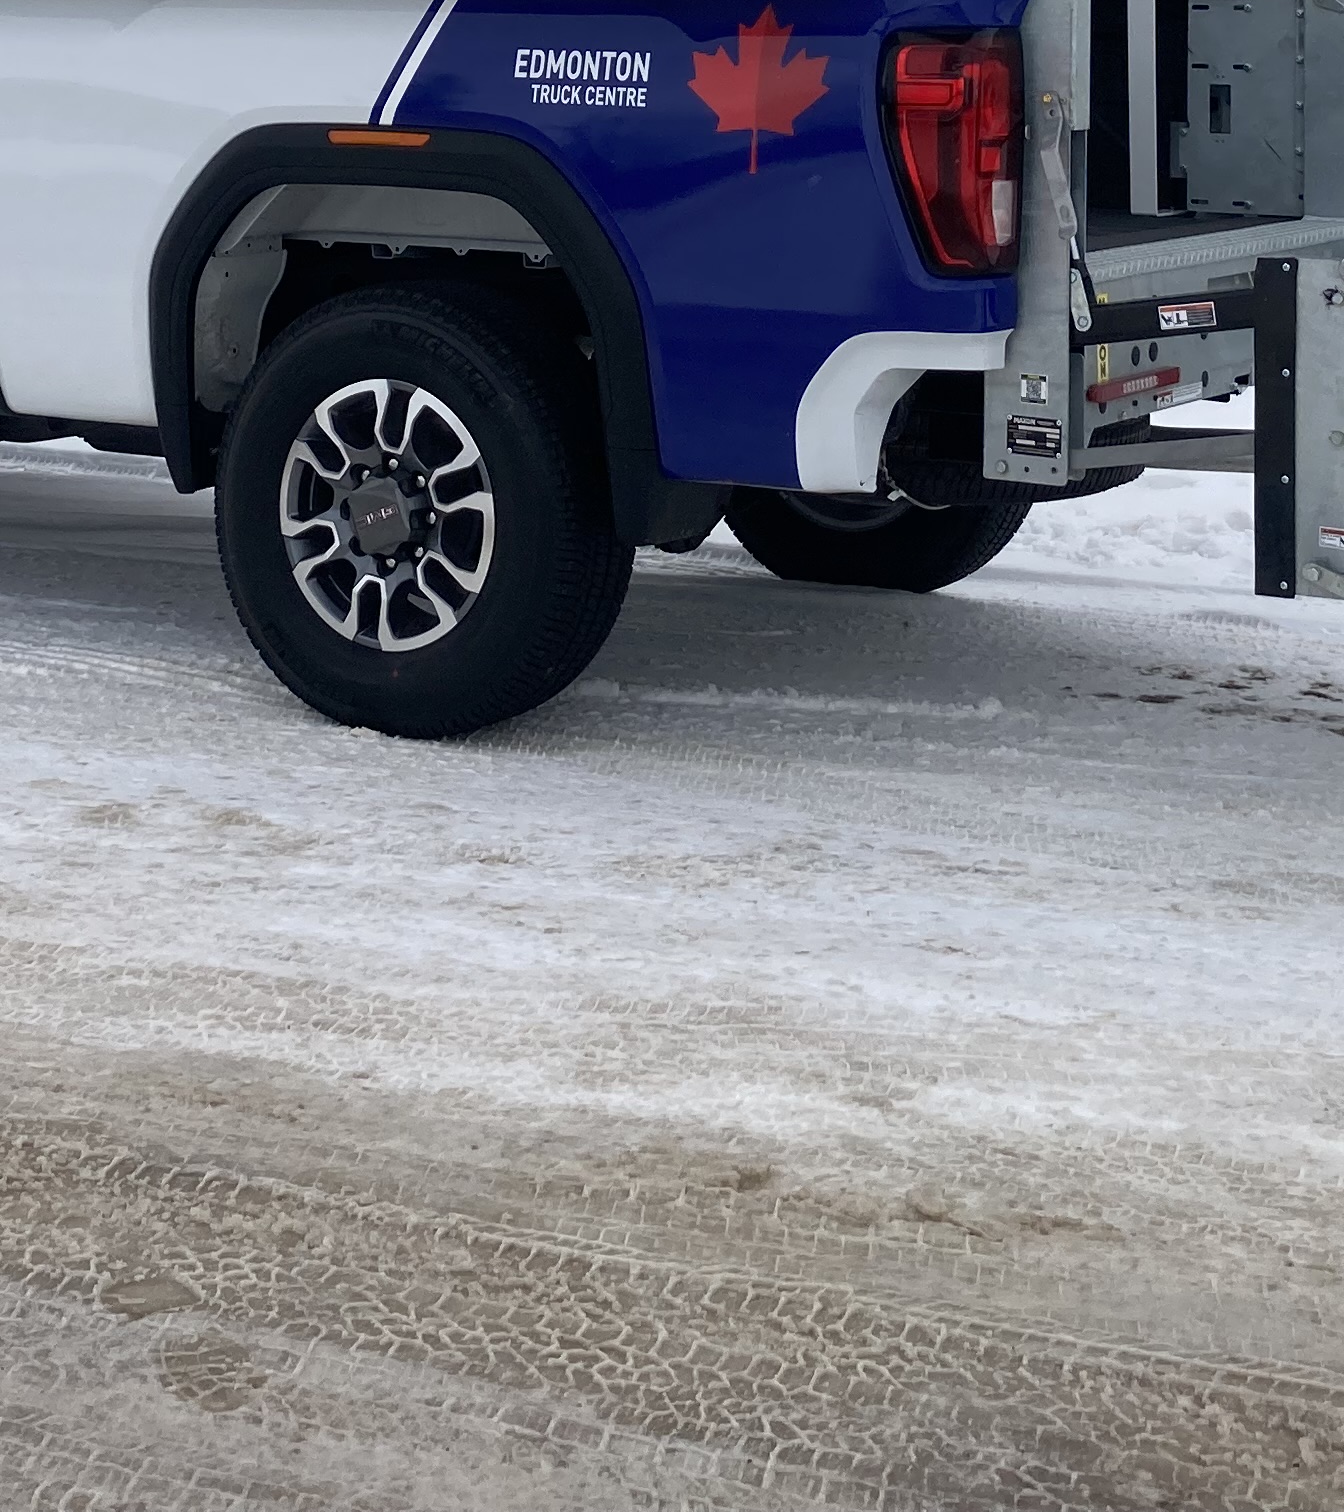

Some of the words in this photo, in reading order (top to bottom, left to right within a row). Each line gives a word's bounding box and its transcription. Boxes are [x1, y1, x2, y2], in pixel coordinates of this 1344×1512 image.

[514, 48, 651, 82] EDMONTON
[531, 84, 582, 105] TRUCK
[585, 85, 648, 108] CENTRE
